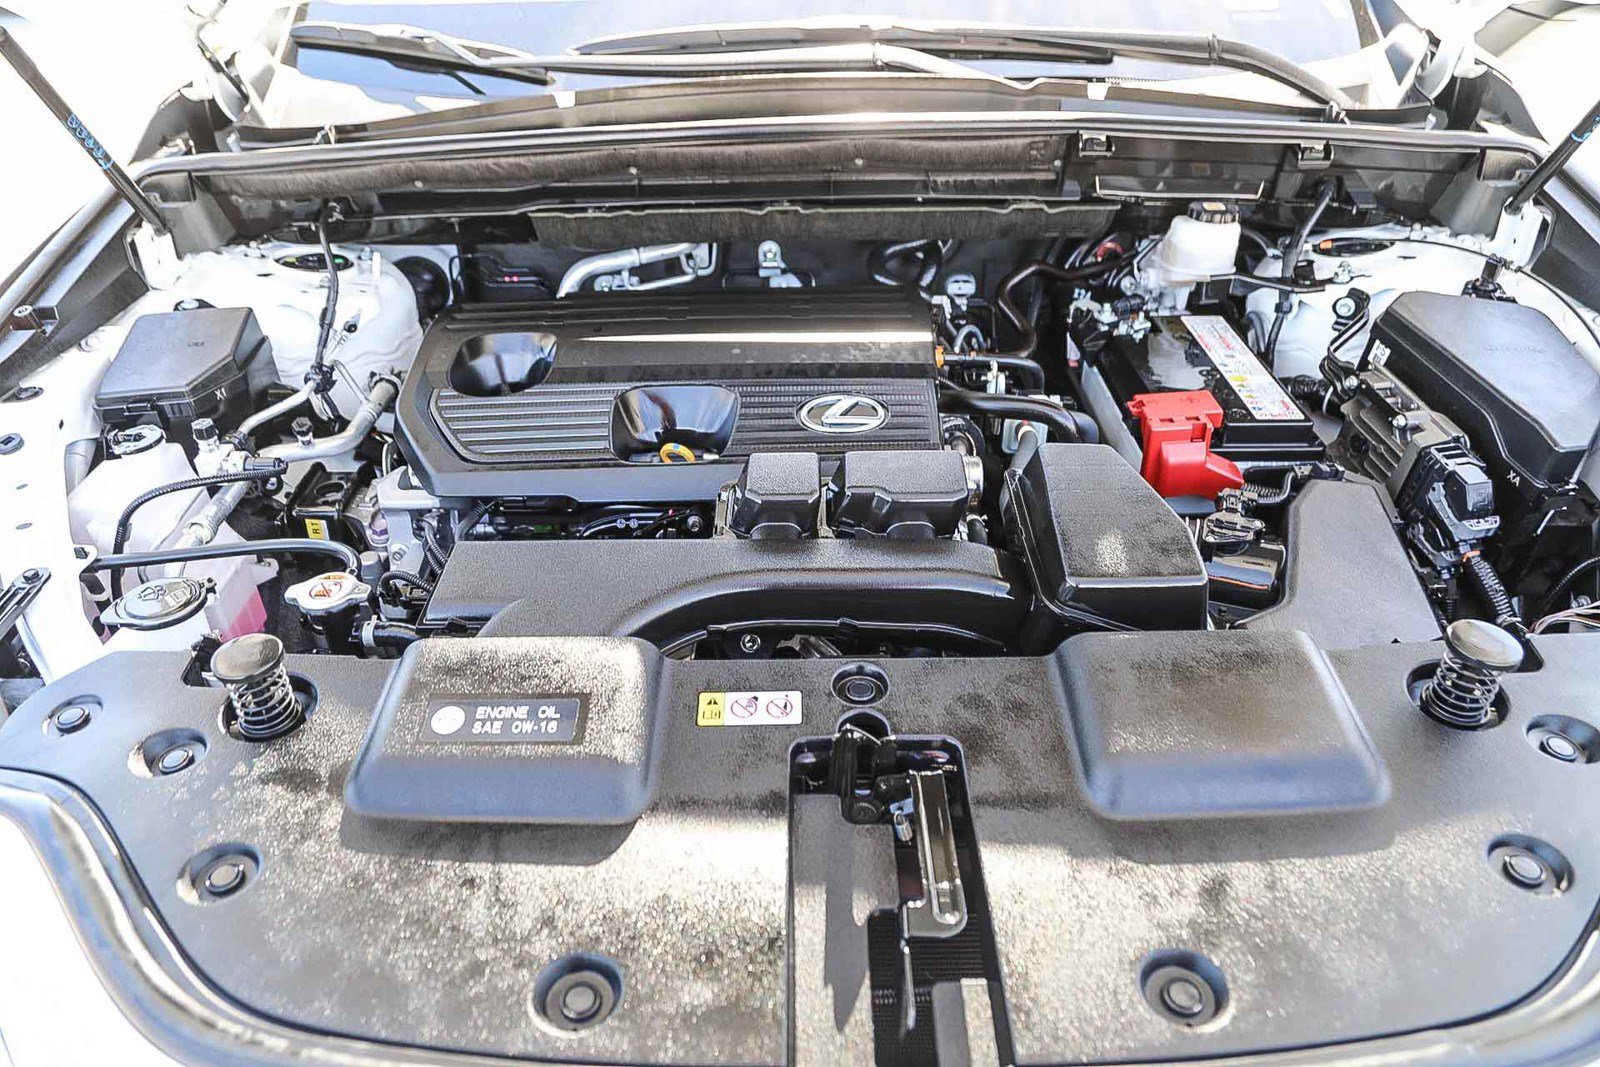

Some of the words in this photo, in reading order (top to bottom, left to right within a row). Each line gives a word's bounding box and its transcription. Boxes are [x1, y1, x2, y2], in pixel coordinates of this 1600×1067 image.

[475, 705, 529, 719] ENGINE
[537, 706, 561, 718] OIL
[472, 720, 502, 734] SAE
